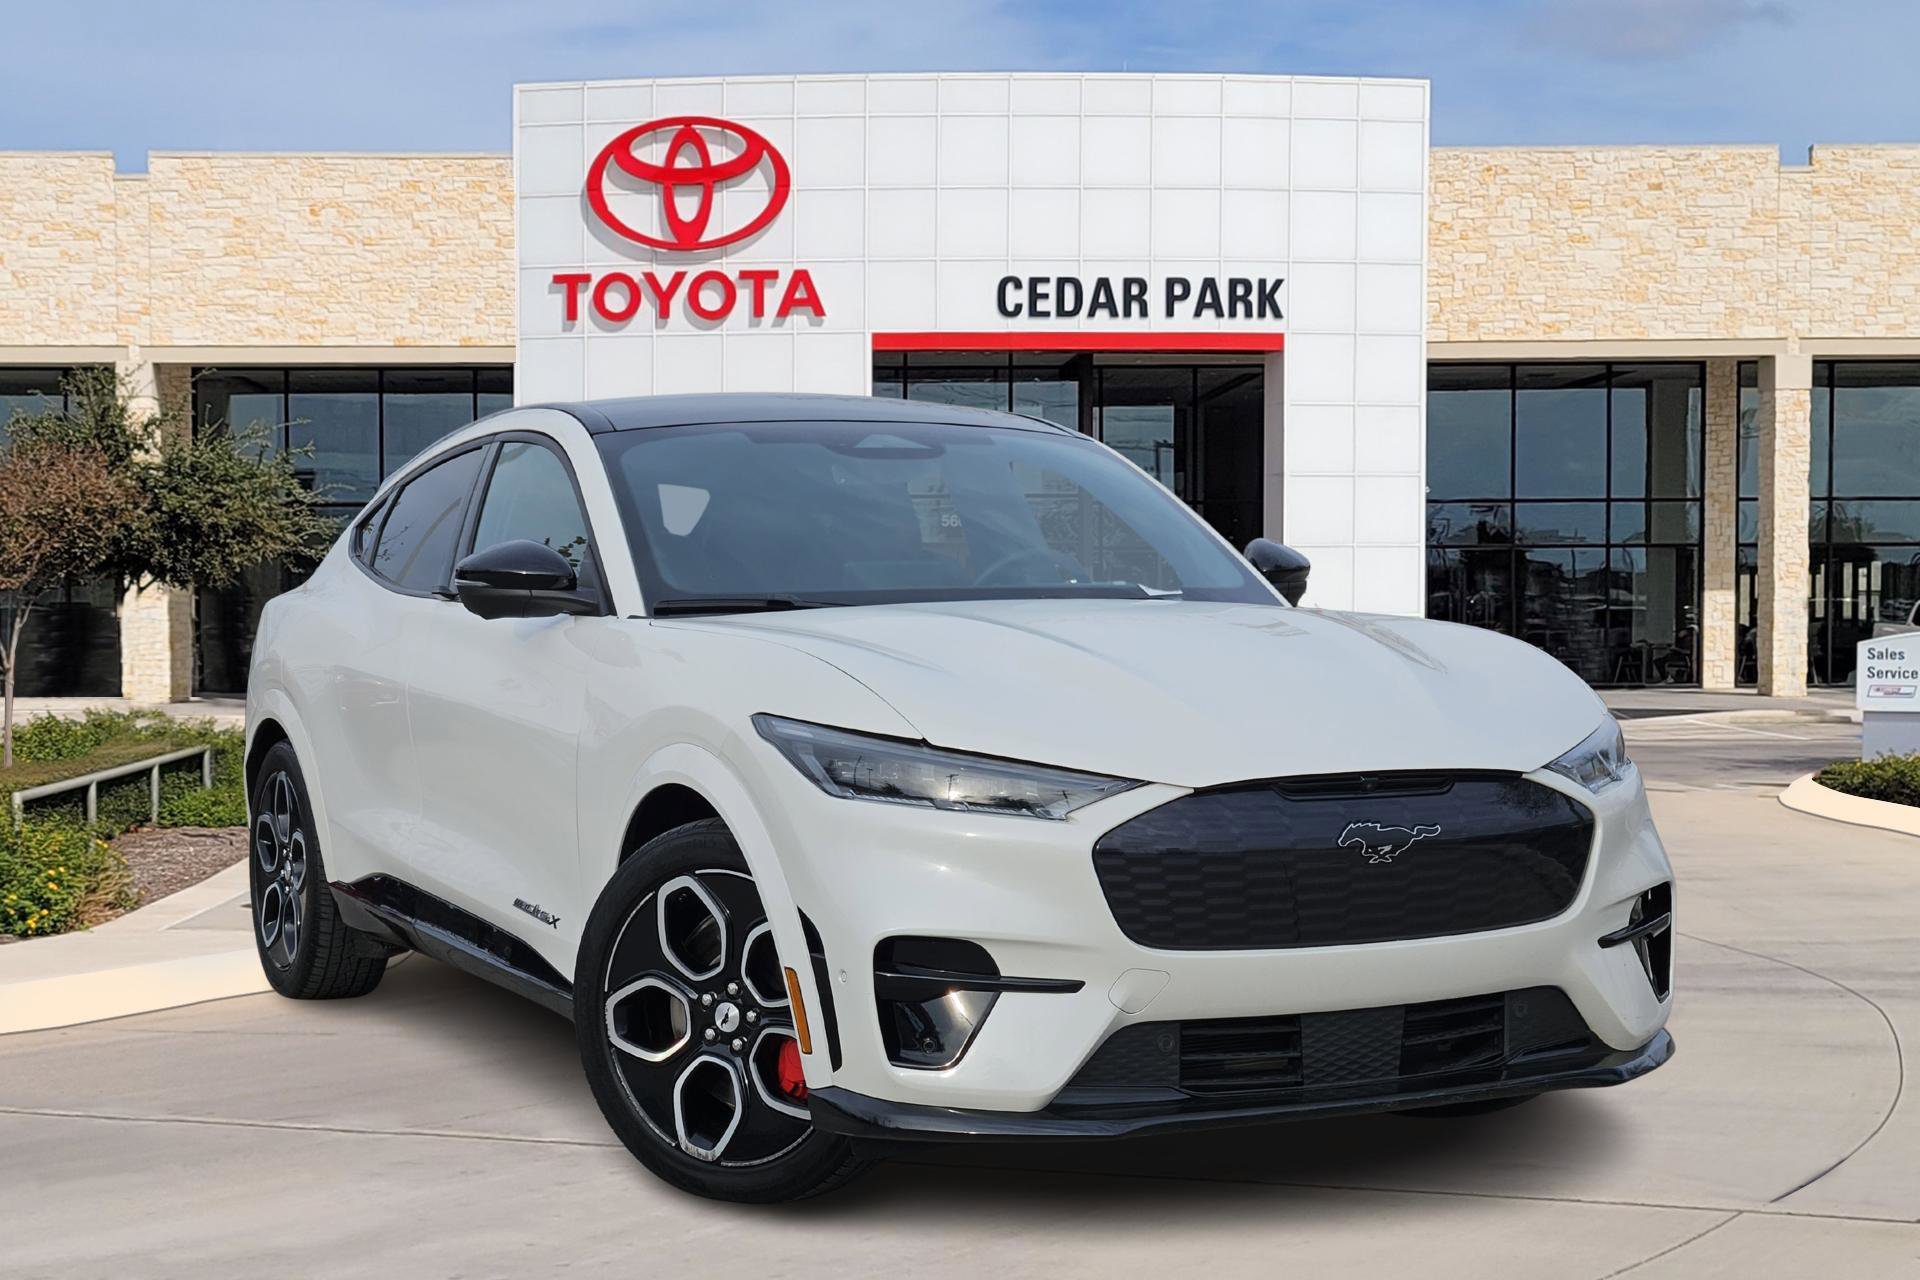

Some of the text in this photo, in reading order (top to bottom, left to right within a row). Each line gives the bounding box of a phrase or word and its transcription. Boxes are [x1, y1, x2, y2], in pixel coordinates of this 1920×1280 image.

[552, 269, 826, 322] TOYOTA
[997, 276, 1284, 319] CEDAR PARK
[941, 514, 962, 527] 56
[1867, 647, 1905, 660] Sales
[1867, 667, 1919, 679] Service
